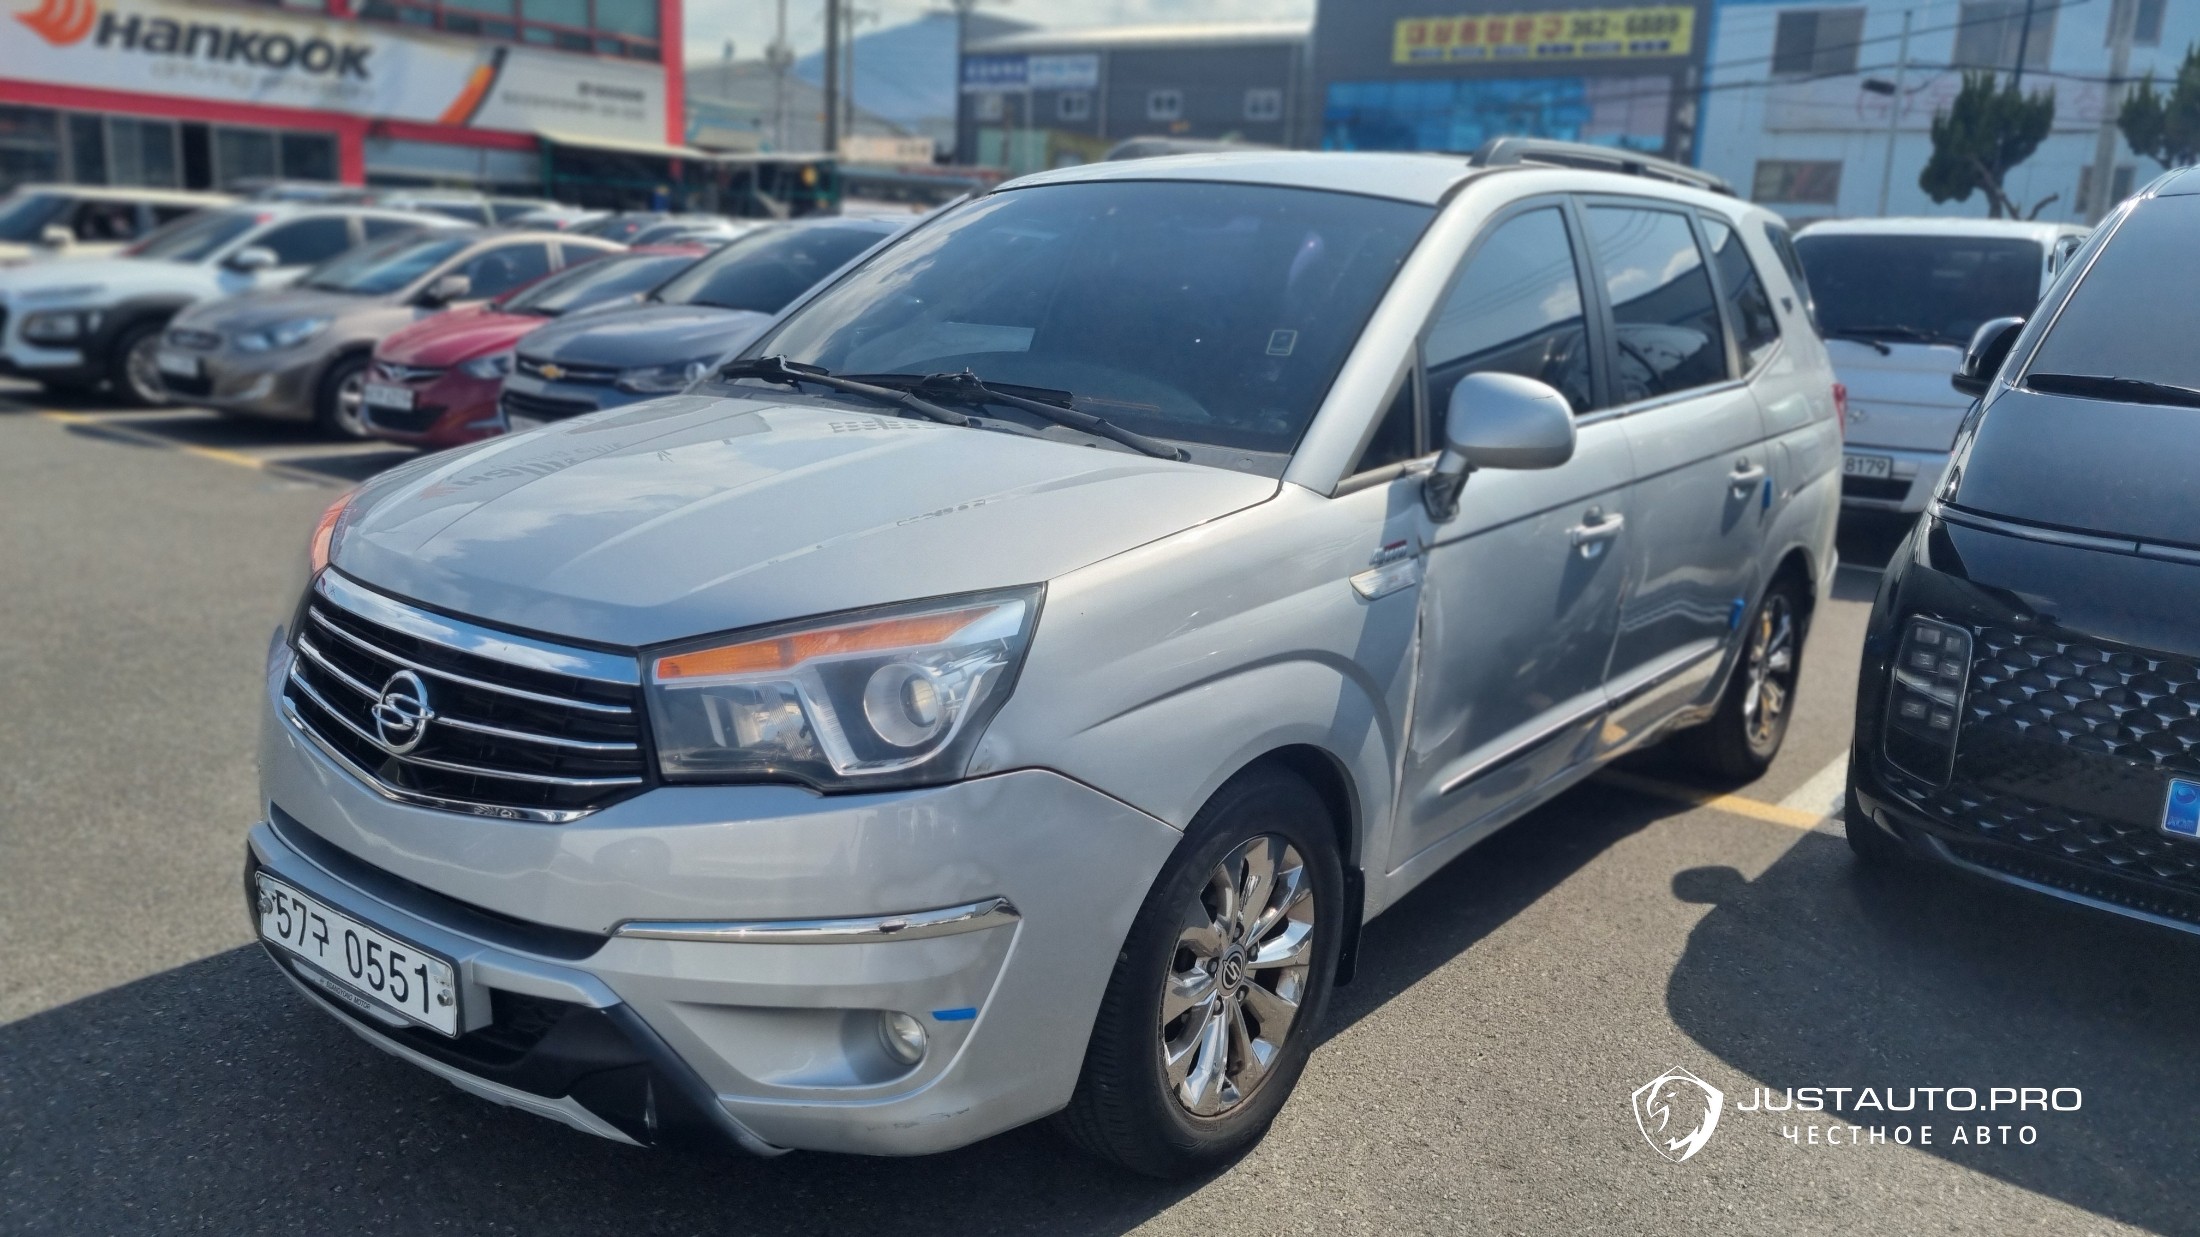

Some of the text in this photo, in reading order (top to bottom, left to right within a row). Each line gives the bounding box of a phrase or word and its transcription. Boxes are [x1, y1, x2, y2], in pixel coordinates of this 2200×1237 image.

[1845, 457, 1887, 474] 8179
[275, 889, 430, 1014] 57구 0551
[354, 996, 371, 1010] MOTOR
